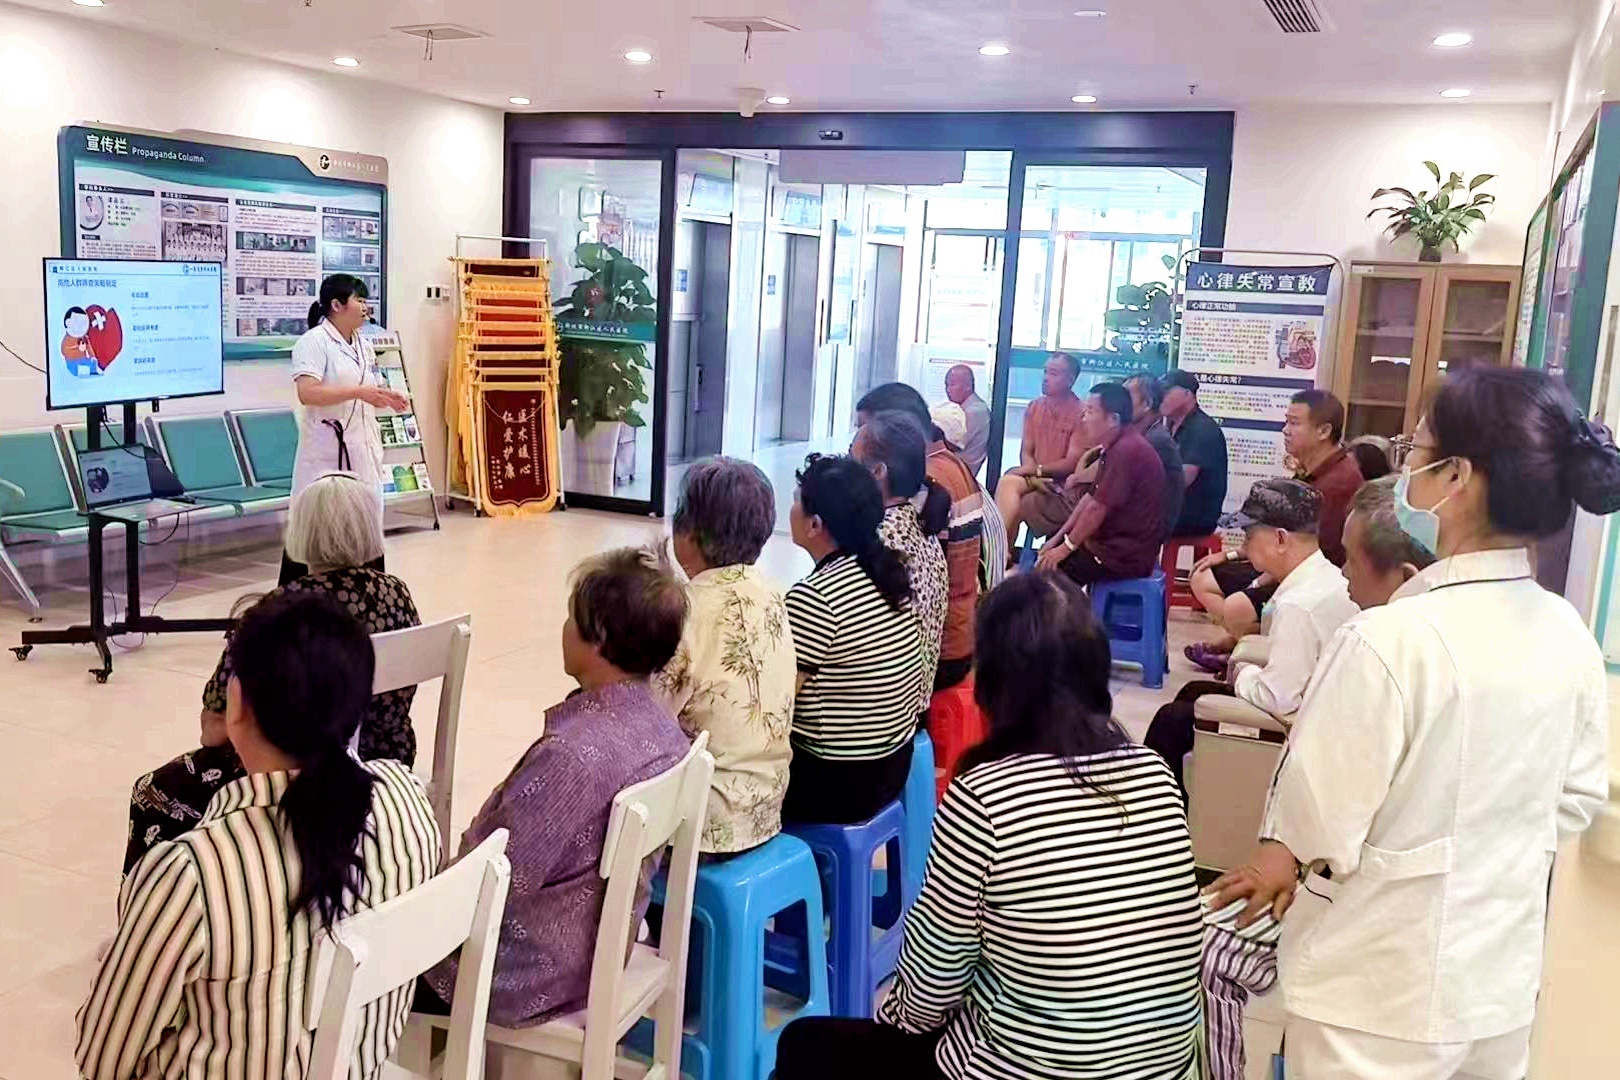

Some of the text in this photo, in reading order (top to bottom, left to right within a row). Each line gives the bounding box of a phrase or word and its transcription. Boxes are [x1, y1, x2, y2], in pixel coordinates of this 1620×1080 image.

[86, 134, 128, 155] 宣传栏
[132, 147, 204, 163] Propaganda Column
[1197, 271, 1317, 293] 心律失常宣教
